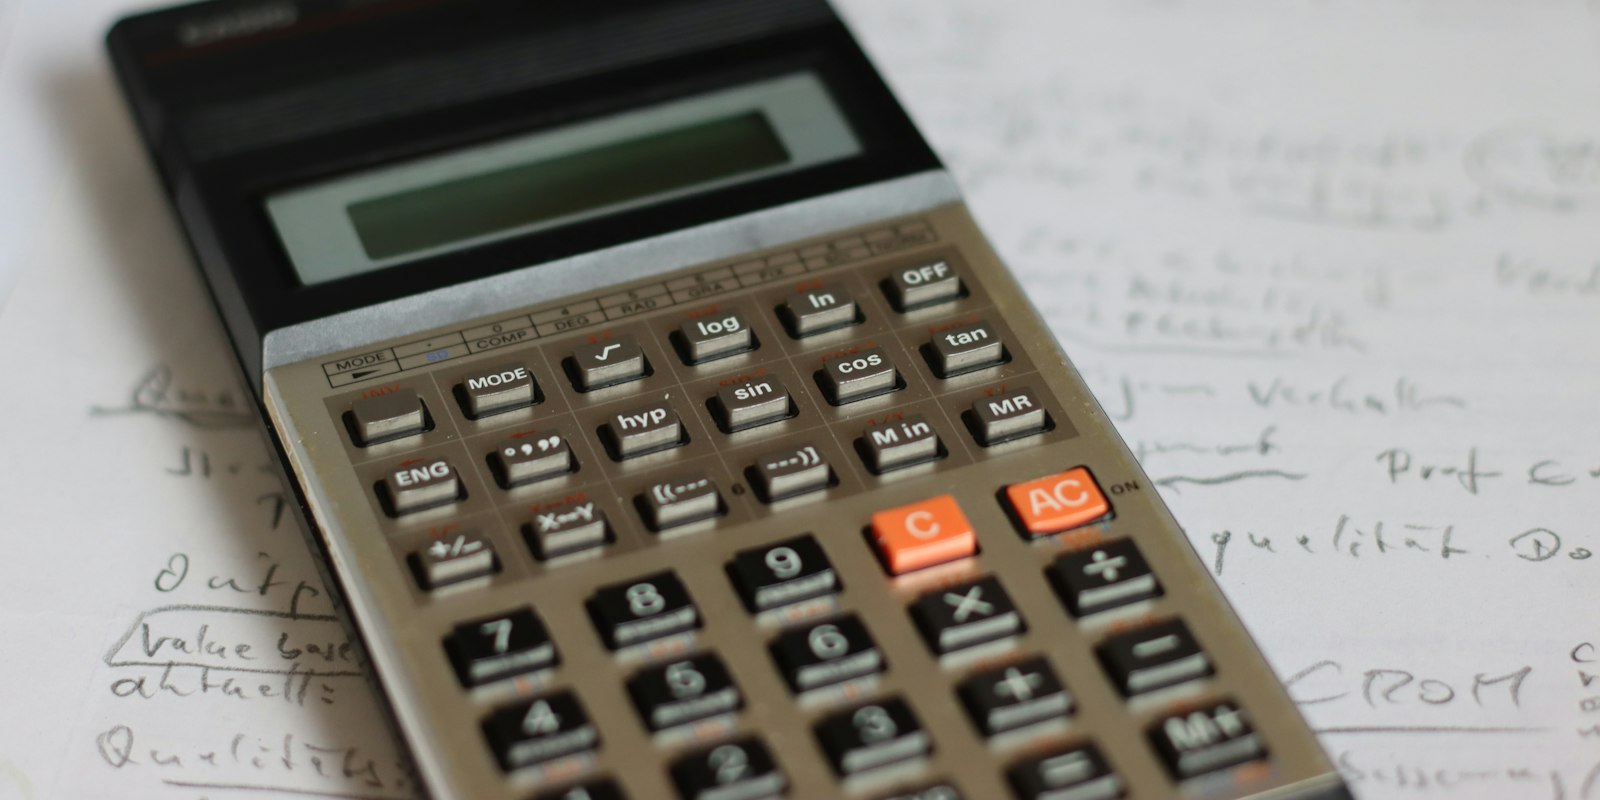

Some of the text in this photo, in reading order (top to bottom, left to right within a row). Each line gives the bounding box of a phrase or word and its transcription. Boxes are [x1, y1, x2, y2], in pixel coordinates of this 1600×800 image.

[903, 261, 947, 285] OFF
[621, 299, 657, 314] RAD
[808, 292, 836, 309] ln
[554, 315, 590, 332] DEG
[696, 316, 741, 337] log
[476, 329, 528, 349] COMP
[944, 326, 989, 348] tan
[335, 351, 387, 371] MODE
[838, 353, 883, 375] cos
[468, 366, 528, 391] MODE
[734, 381, 773, 401] sin
[989, 394, 1034, 417] MR
[617, 406, 668, 431] hyp
[871, 417, 931, 447] M in
[394, 461, 451, 488] ENG
[1027, 478, 1092, 517] AC
[1110, 478, 1142, 497] ON
[904, 510, 942, 540] C
[764, 546, 803, 579] 9
[625, 582, 666, 617] 8
[140, 623, 259, 661] Value
[480, 617, 514, 653] 7
[808, 623, 850, 660] 6
[665, 660, 707, 699] 5
[522, 699, 562, 736] 4
[853, 705, 899, 745] 3
[707, 744, 750, 785] 2
